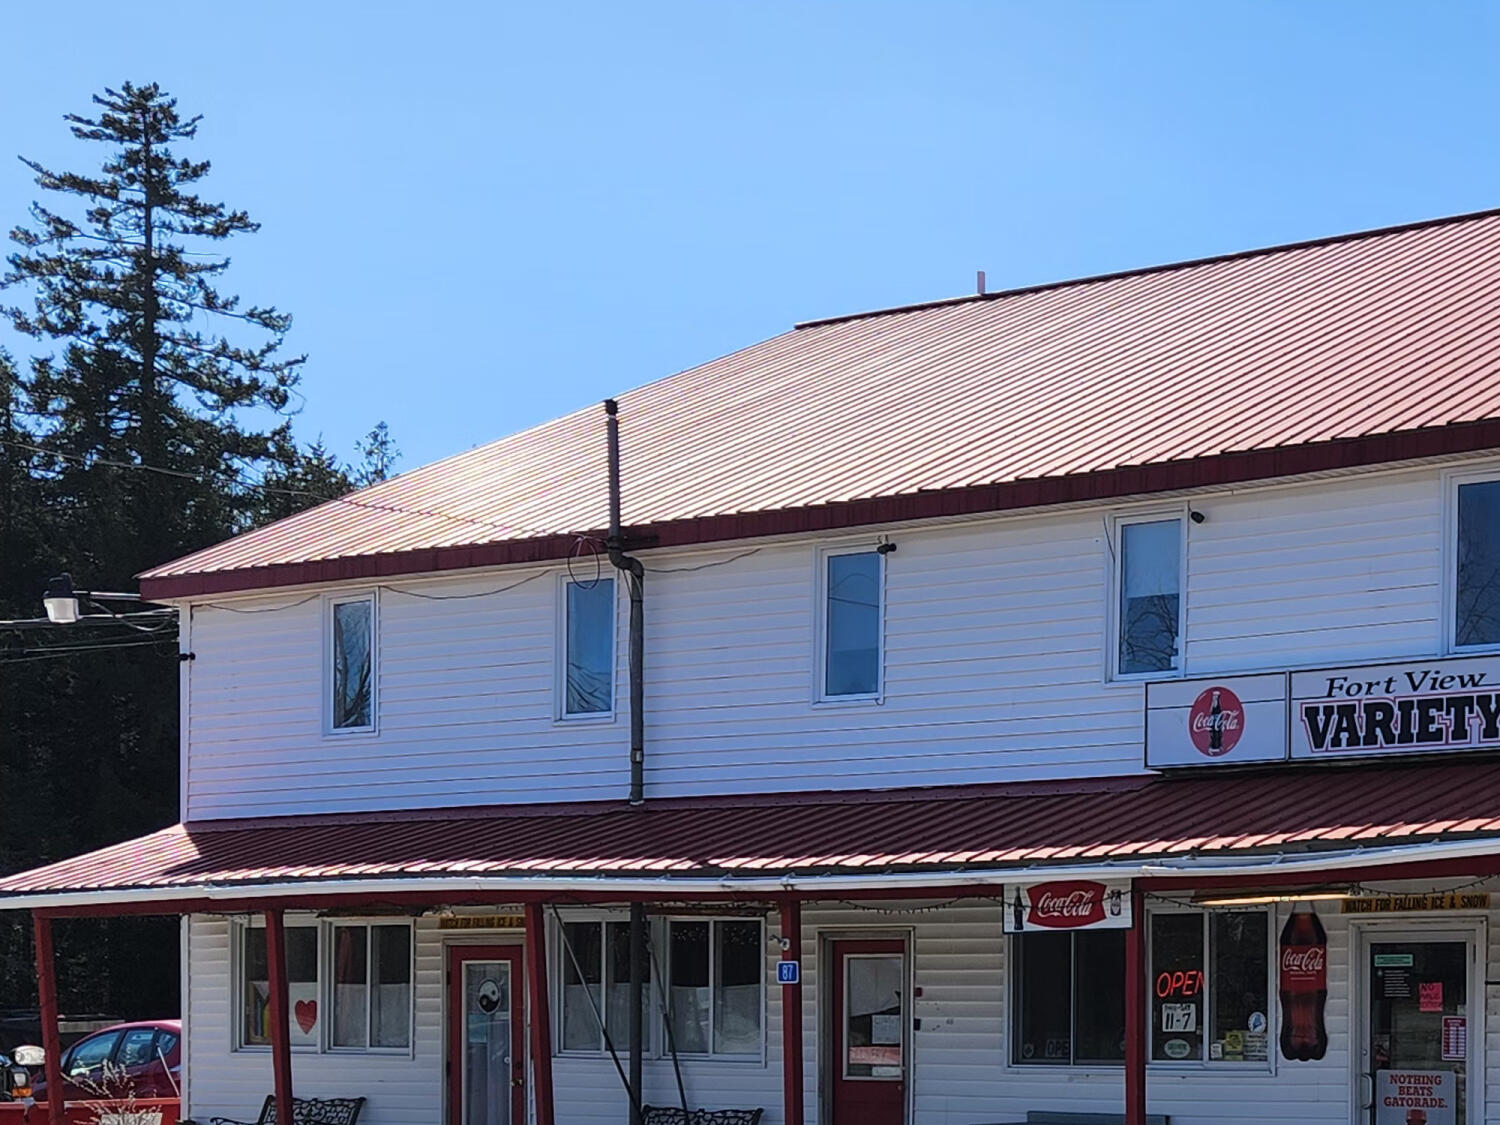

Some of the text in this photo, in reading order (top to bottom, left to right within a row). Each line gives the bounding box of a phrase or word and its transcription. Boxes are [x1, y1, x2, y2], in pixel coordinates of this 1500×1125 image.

[1325, 670, 1487, 698] Fort View
[1193, 710, 1240, 733] Coca-Cola
[1037, 889, 1096, 918] Coca-Cola
[1375, 899, 1392, 912] FOR
[1394, 897, 1427, 911] FALLING
[1431, 896, 1446, 909] ICE
[1448, 896, 1457, 909] &
[1461, 894, 1488, 908] SNOW
[1283, 948, 1324, 972] Coca-Cola
[782, 964, 794, 981] 87
[1156, 970, 1206, 998] OPEN
[1164, 1012, 1193, 1030] 11-7
[1389, 1074, 1443, 1086] NOTHING
[1398, 1086, 1434, 1096] BEATS
[1383, 1097, 1449, 1109] GATORADE.
